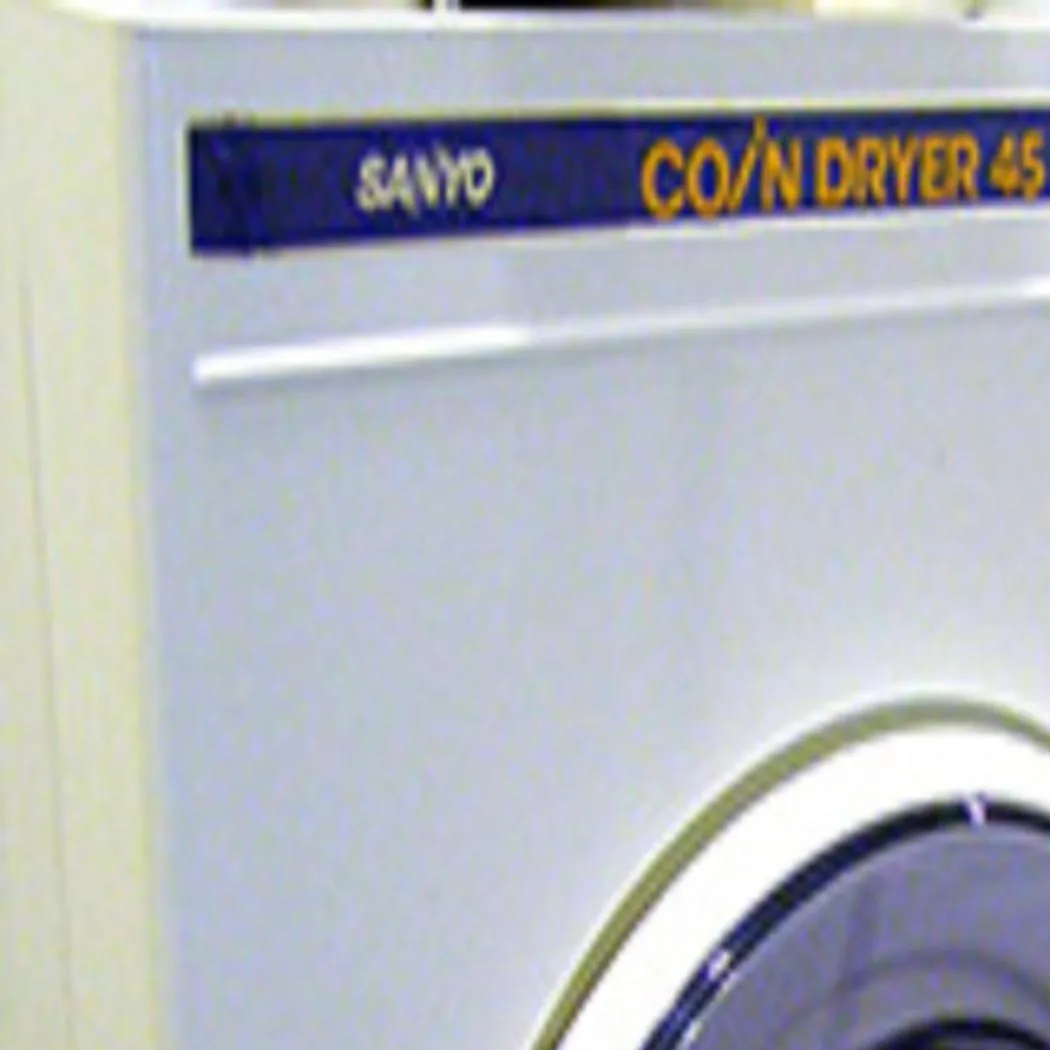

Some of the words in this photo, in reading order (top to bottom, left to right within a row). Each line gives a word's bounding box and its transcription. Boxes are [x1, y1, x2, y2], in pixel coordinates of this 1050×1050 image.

[355, 144, 496, 214] SANYO
[814, 131, 982, 212] DRYER
[989, 129, 1047, 203] 45
